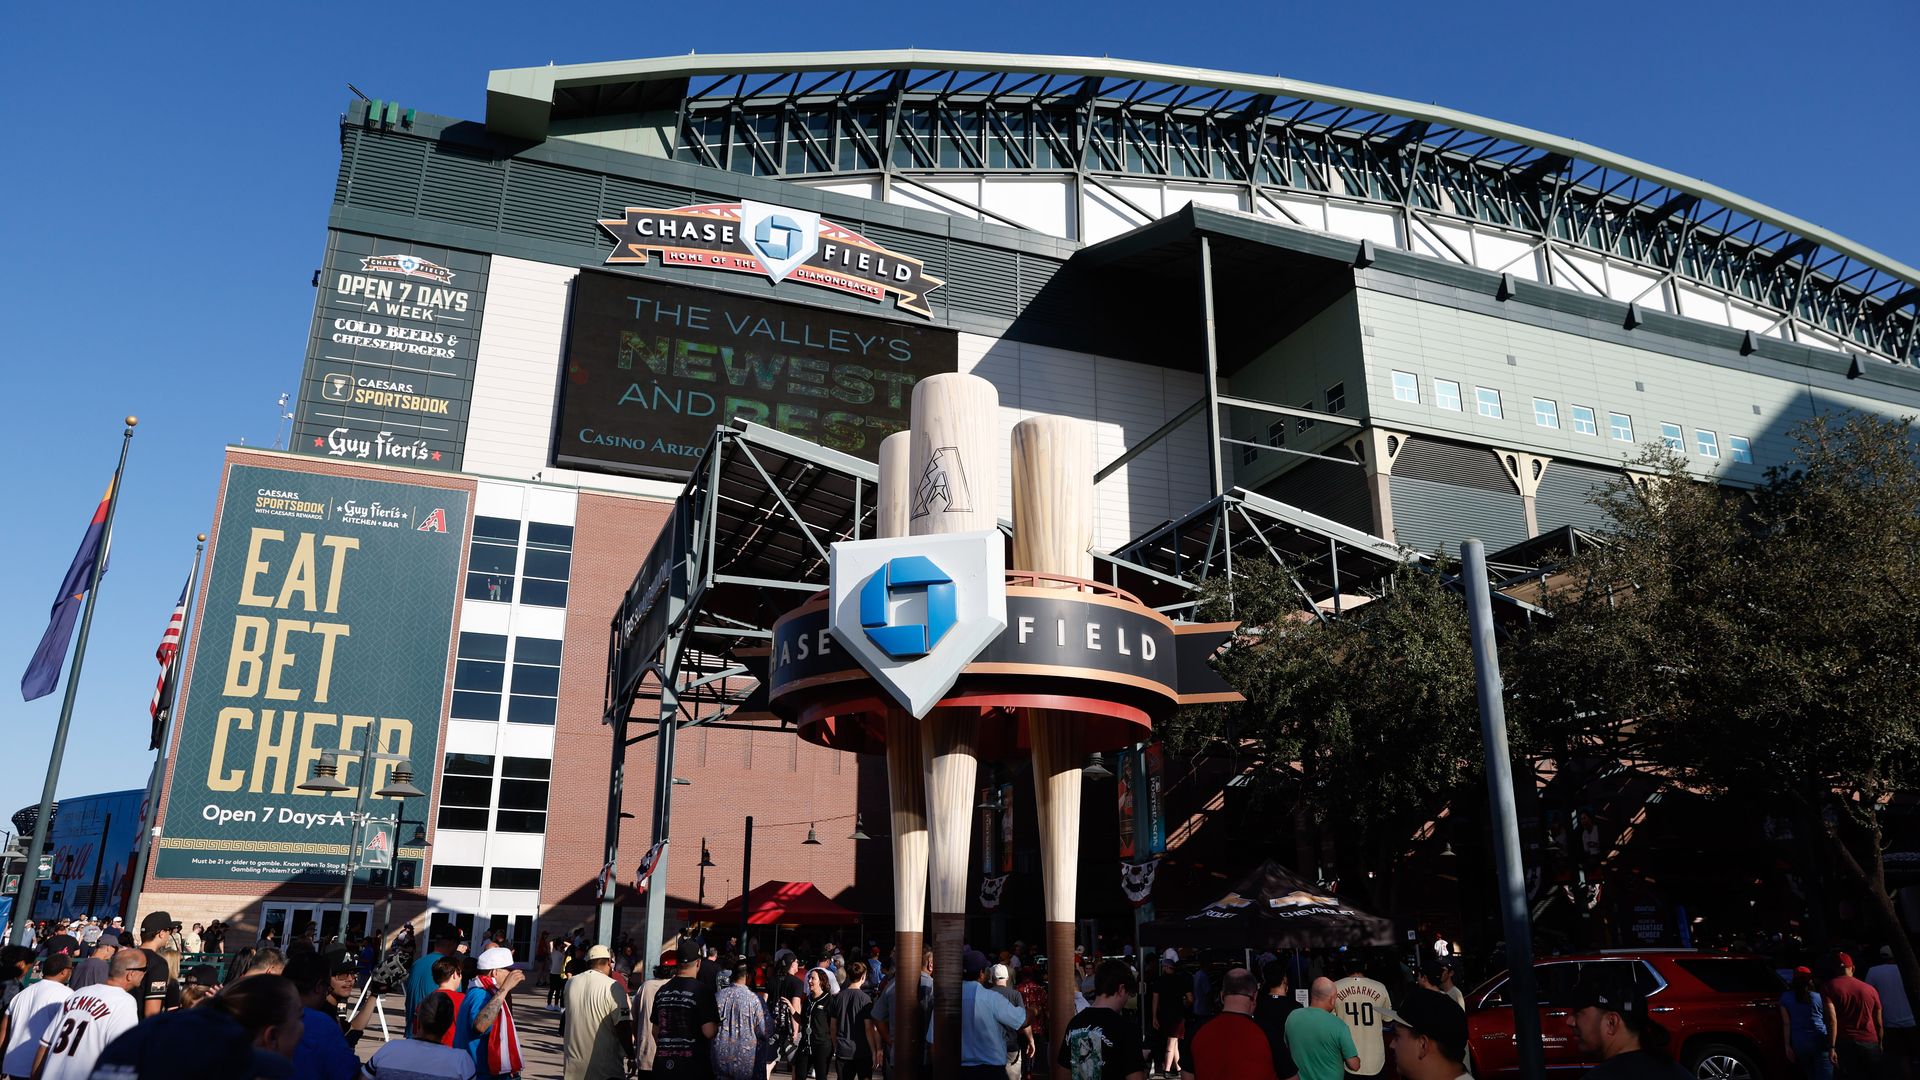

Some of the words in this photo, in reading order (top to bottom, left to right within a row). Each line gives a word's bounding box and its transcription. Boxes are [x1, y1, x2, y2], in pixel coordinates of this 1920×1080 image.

[637, 218, 734, 244] CHASE
[823, 244, 912, 282] FIELD
[420, 265, 445, 276] FIELD
[669, 252, 703, 263] HOME
[712, 256, 727, 265] OF
[734, 259, 756, 269] THE
[798, 269, 880, 295] DIAMONDBACKS
[338, 274, 393, 301] OPEN
[399, 283, 412, 302] 7
[416, 286, 469, 312] DAYS
[367, 301, 379, 313] A
[386, 304, 433, 321] WEEK
[334, 318, 382, 335] COLD
[385, 325, 444, 345] BEERS
[447, 335, 459, 346] &
[626, 296, 712, 331] THE
[725, 311, 912, 362] VALLEY'S
[332, 333, 456, 359] CHEESEBURGERS
[617, 330, 916, 410] NEWEST
[357, 378, 413, 393] CAESARS
[355, 389, 449, 414] SPORTSBOOK
[617, 383, 716, 418] AND
[724, 396, 910, 452] BEST
[328, 427, 371, 459] Guy
[375, 431, 429, 460] Fieri's
[255, 496, 325, 514] SPORTSBOOK
[258, 489, 299, 500] CAESARS
[344, 500, 369, 518] Guy
[371, 502, 400, 519] Fieri's
[342, 517, 377, 526] KITCHEN
[382, 520, 399, 528] BAR
[238, 527, 360, 614] EAT
[1017, 616, 1158, 661] FIELD
[222, 615, 350, 703] BET
[206, 706, 414, 801] CHEER
[203, 804, 256, 826] Open
[262, 807, 275, 822] 7
[279, 808, 327, 829] Days
[330, 811, 345, 826] A
[231, 866, 260, 874] Gambling
[1279, 907, 1356, 918] CHEVROLET
[1337, 986, 1381, 1002] BUMGARNER
[63, 996, 111, 1020] KENNEDY
[1345, 1002, 1374, 1026] 40
[53, 1018, 89, 1057] 31
